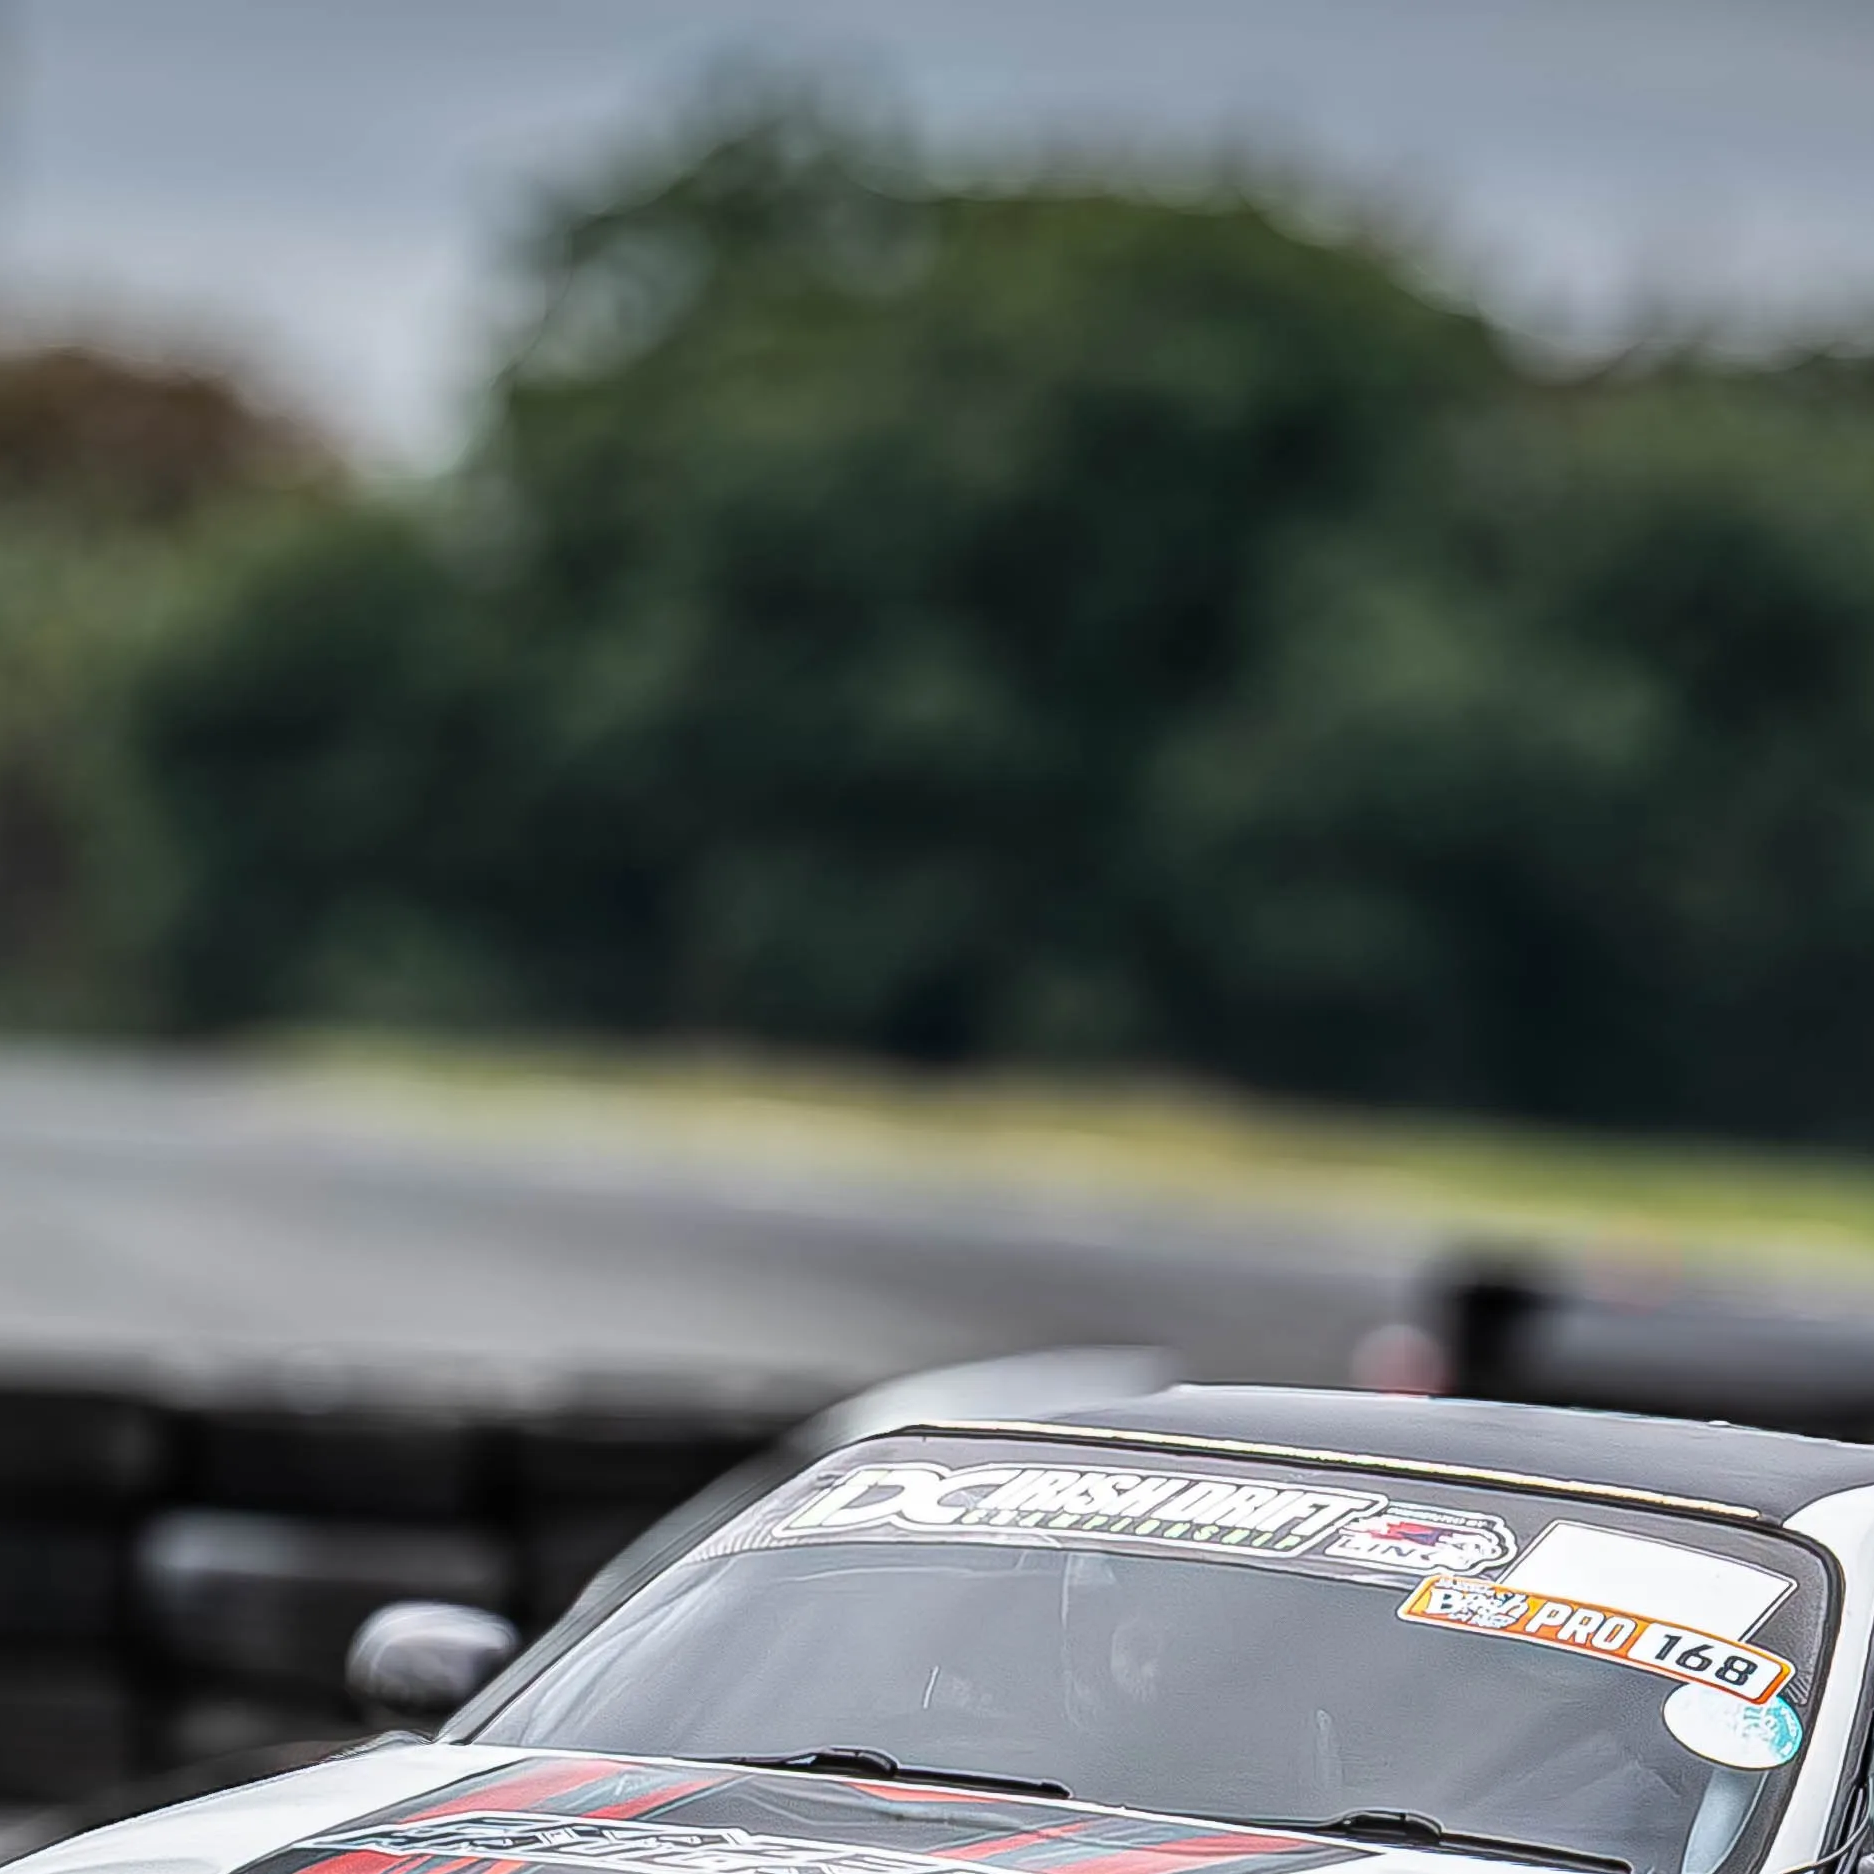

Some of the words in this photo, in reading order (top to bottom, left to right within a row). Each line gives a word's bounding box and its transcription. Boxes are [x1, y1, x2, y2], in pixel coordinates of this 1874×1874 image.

[977, 1468, 1190, 1517] IRISH
[1150, 1482, 1375, 1536] DRIFT
[1525, 1600, 1636, 1651] PRO
[1655, 1633, 1758, 1686] 168
